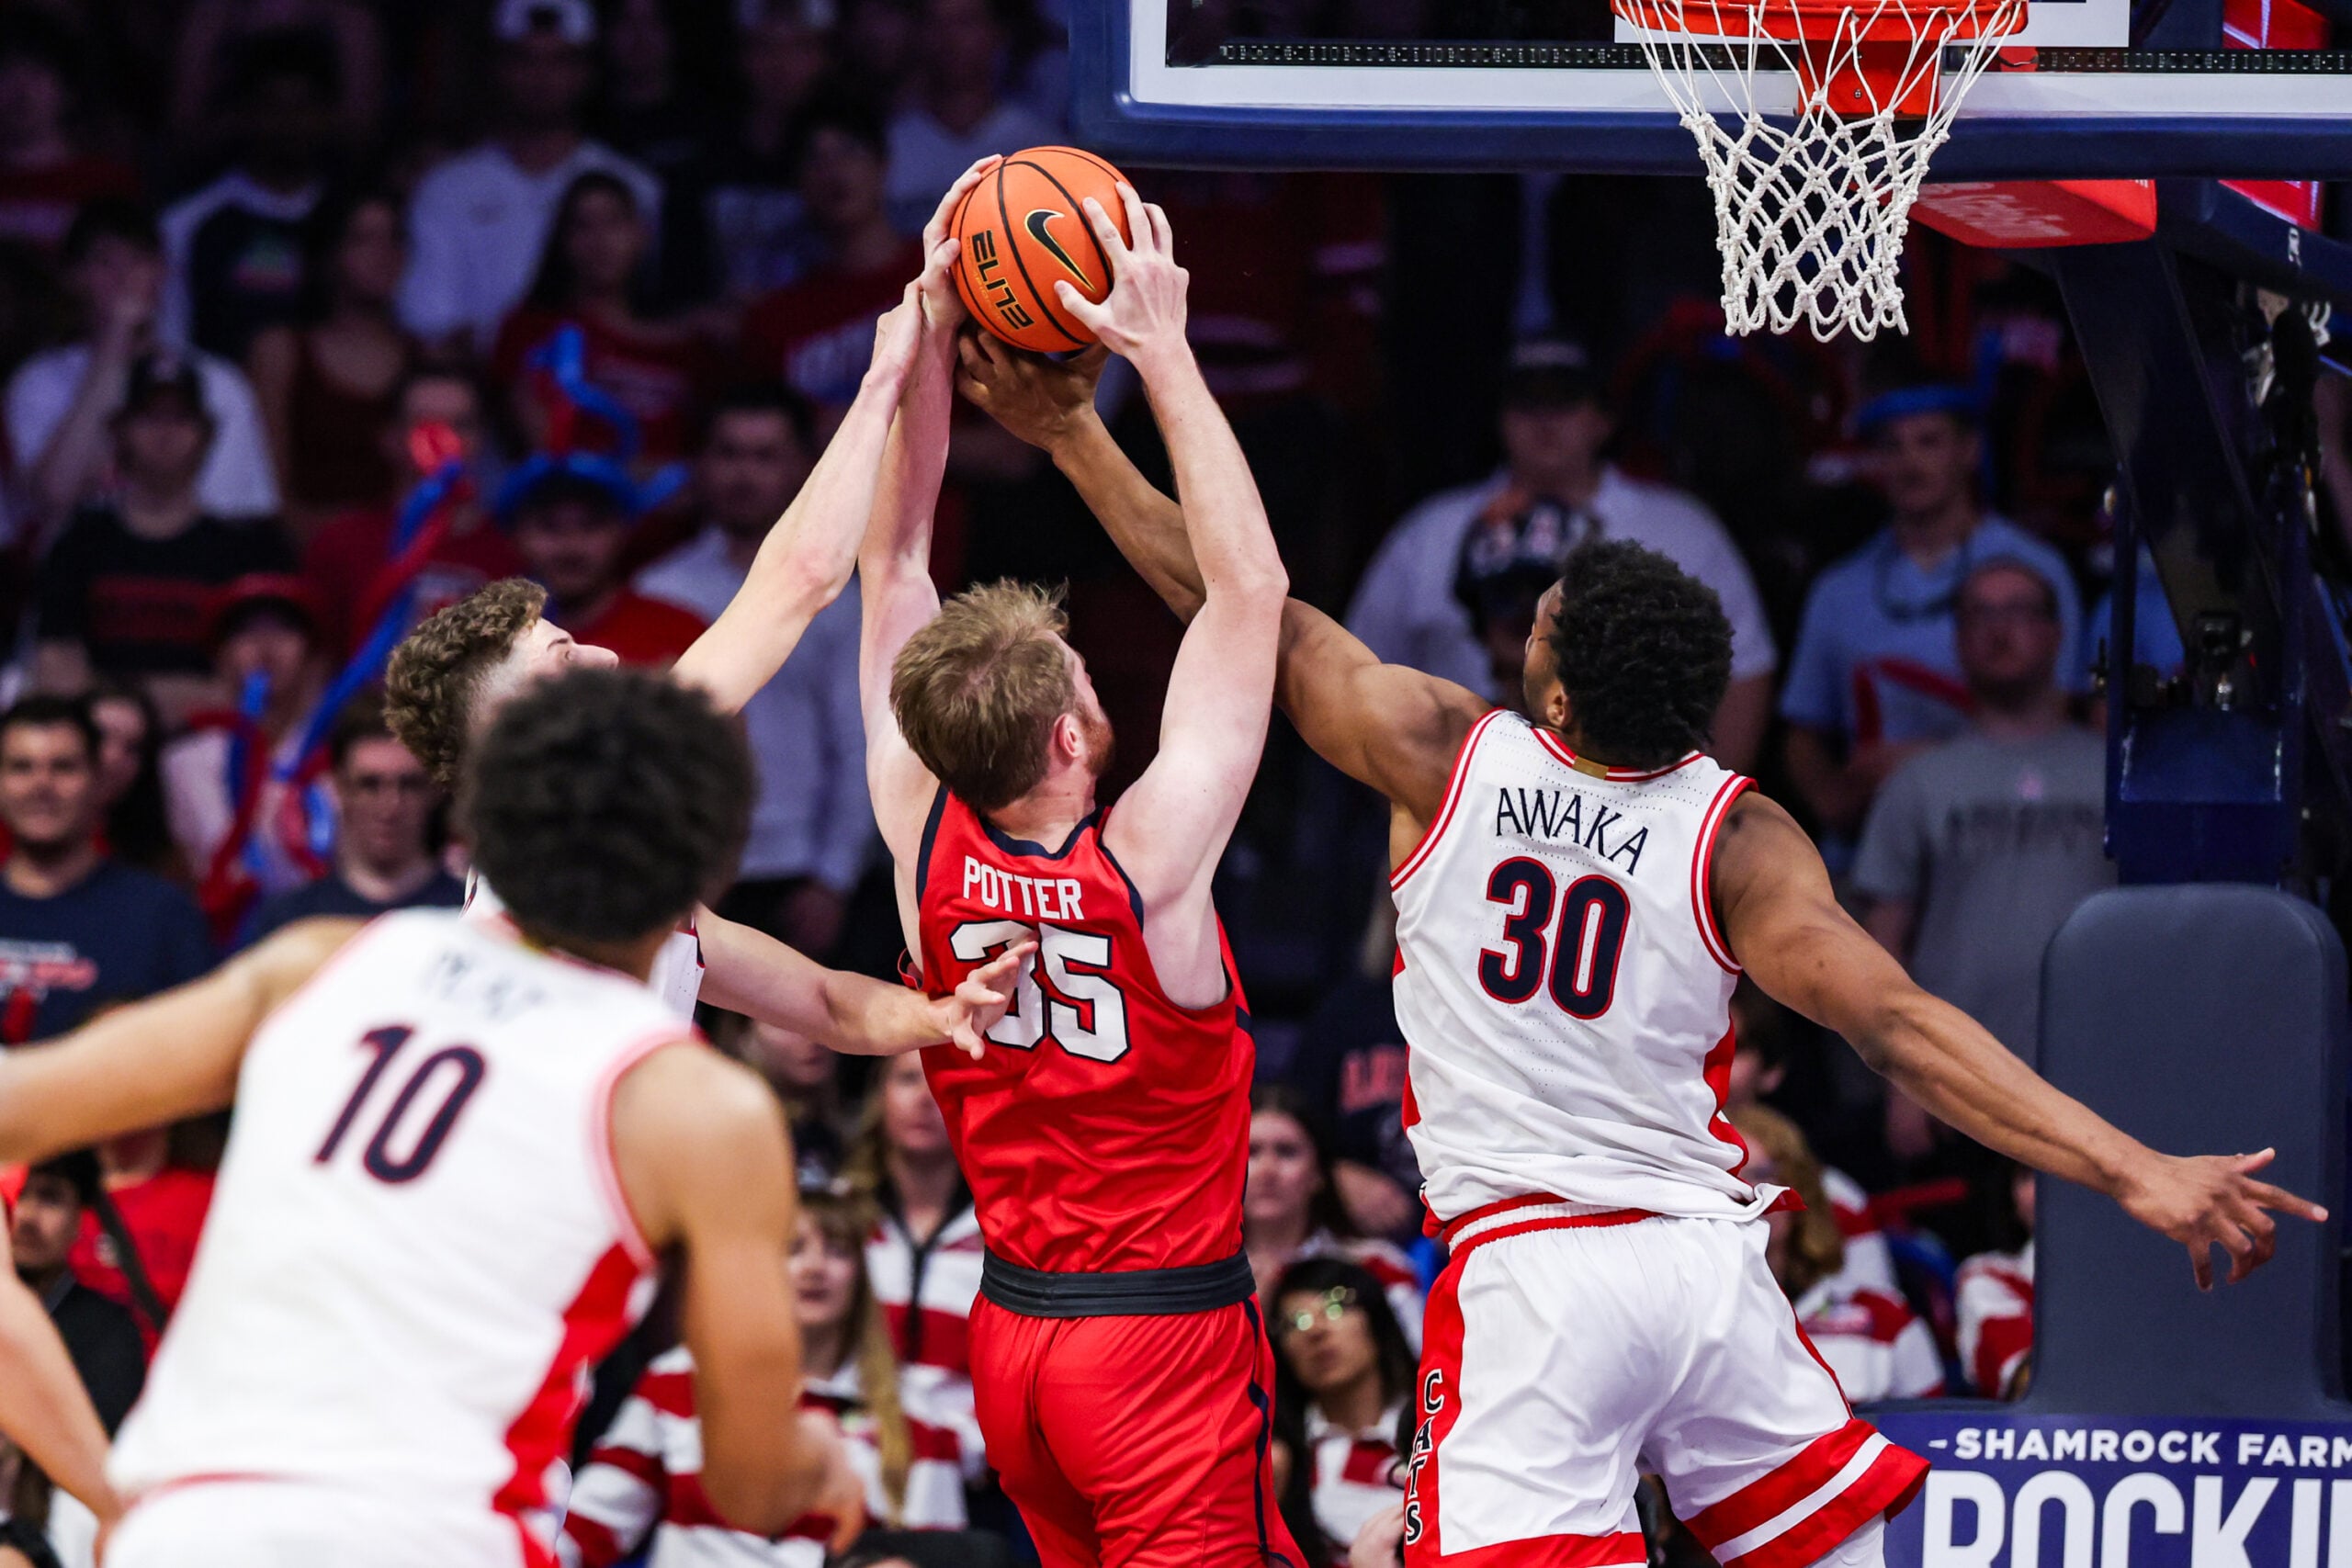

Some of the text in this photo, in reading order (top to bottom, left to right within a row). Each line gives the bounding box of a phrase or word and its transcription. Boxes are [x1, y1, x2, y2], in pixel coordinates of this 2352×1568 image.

[971, 229, 1035, 331] ELITE
[963, 854, 1086, 920] POTTER
[1496, 787, 1649, 876] AWAKA
[950, 919, 1132, 1064] 35
[1477, 855, 1632, 1021] 30
[313, 1024, 486, 1184] 10
[1405, 1368, 1446, 1546] CATS
[1954, 1427, 2222, 1464] SHAMROCK
